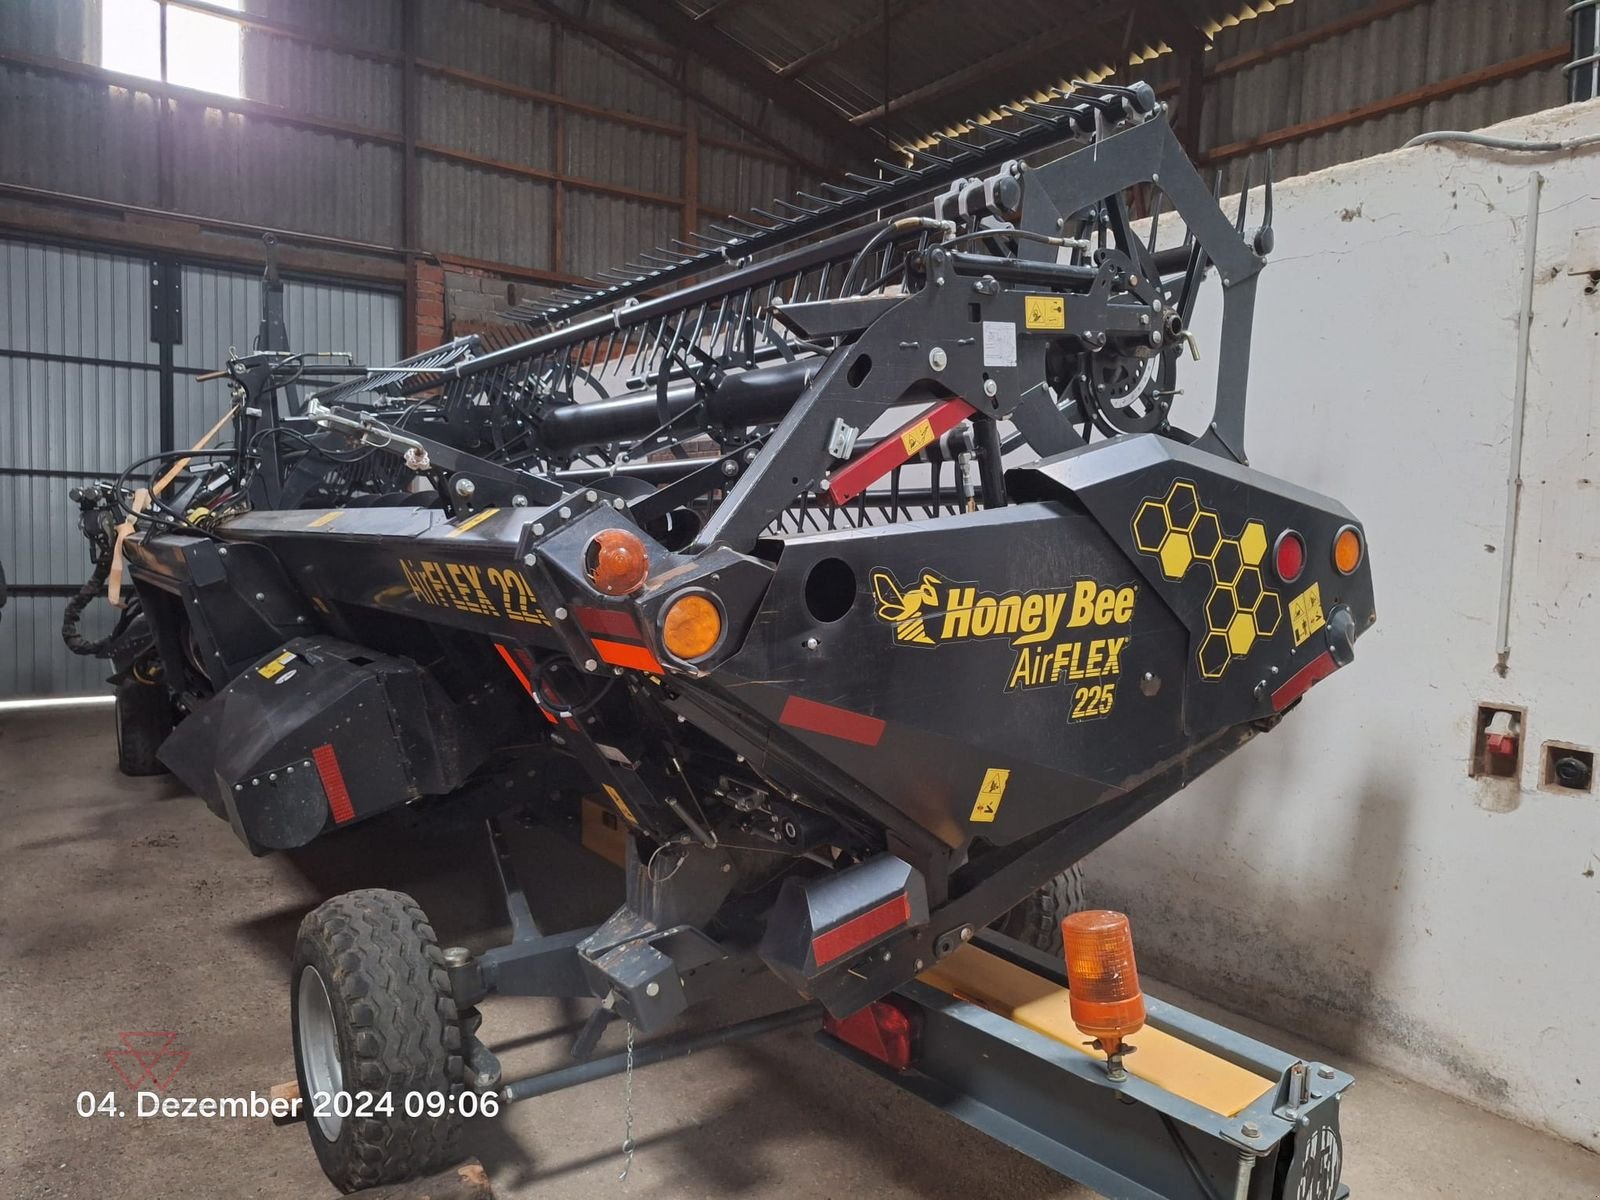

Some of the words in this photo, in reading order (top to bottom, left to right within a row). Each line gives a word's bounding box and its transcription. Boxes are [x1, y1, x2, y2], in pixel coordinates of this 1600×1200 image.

[399, 558, 501, 617] AirFLEX
[940, 587, 1068, 646] Honey
[1066, 580, 1136, 628] Bee
[1009, 637, 1126, 688] AirFLEX
[1071, 683, 1116, 719] 225
